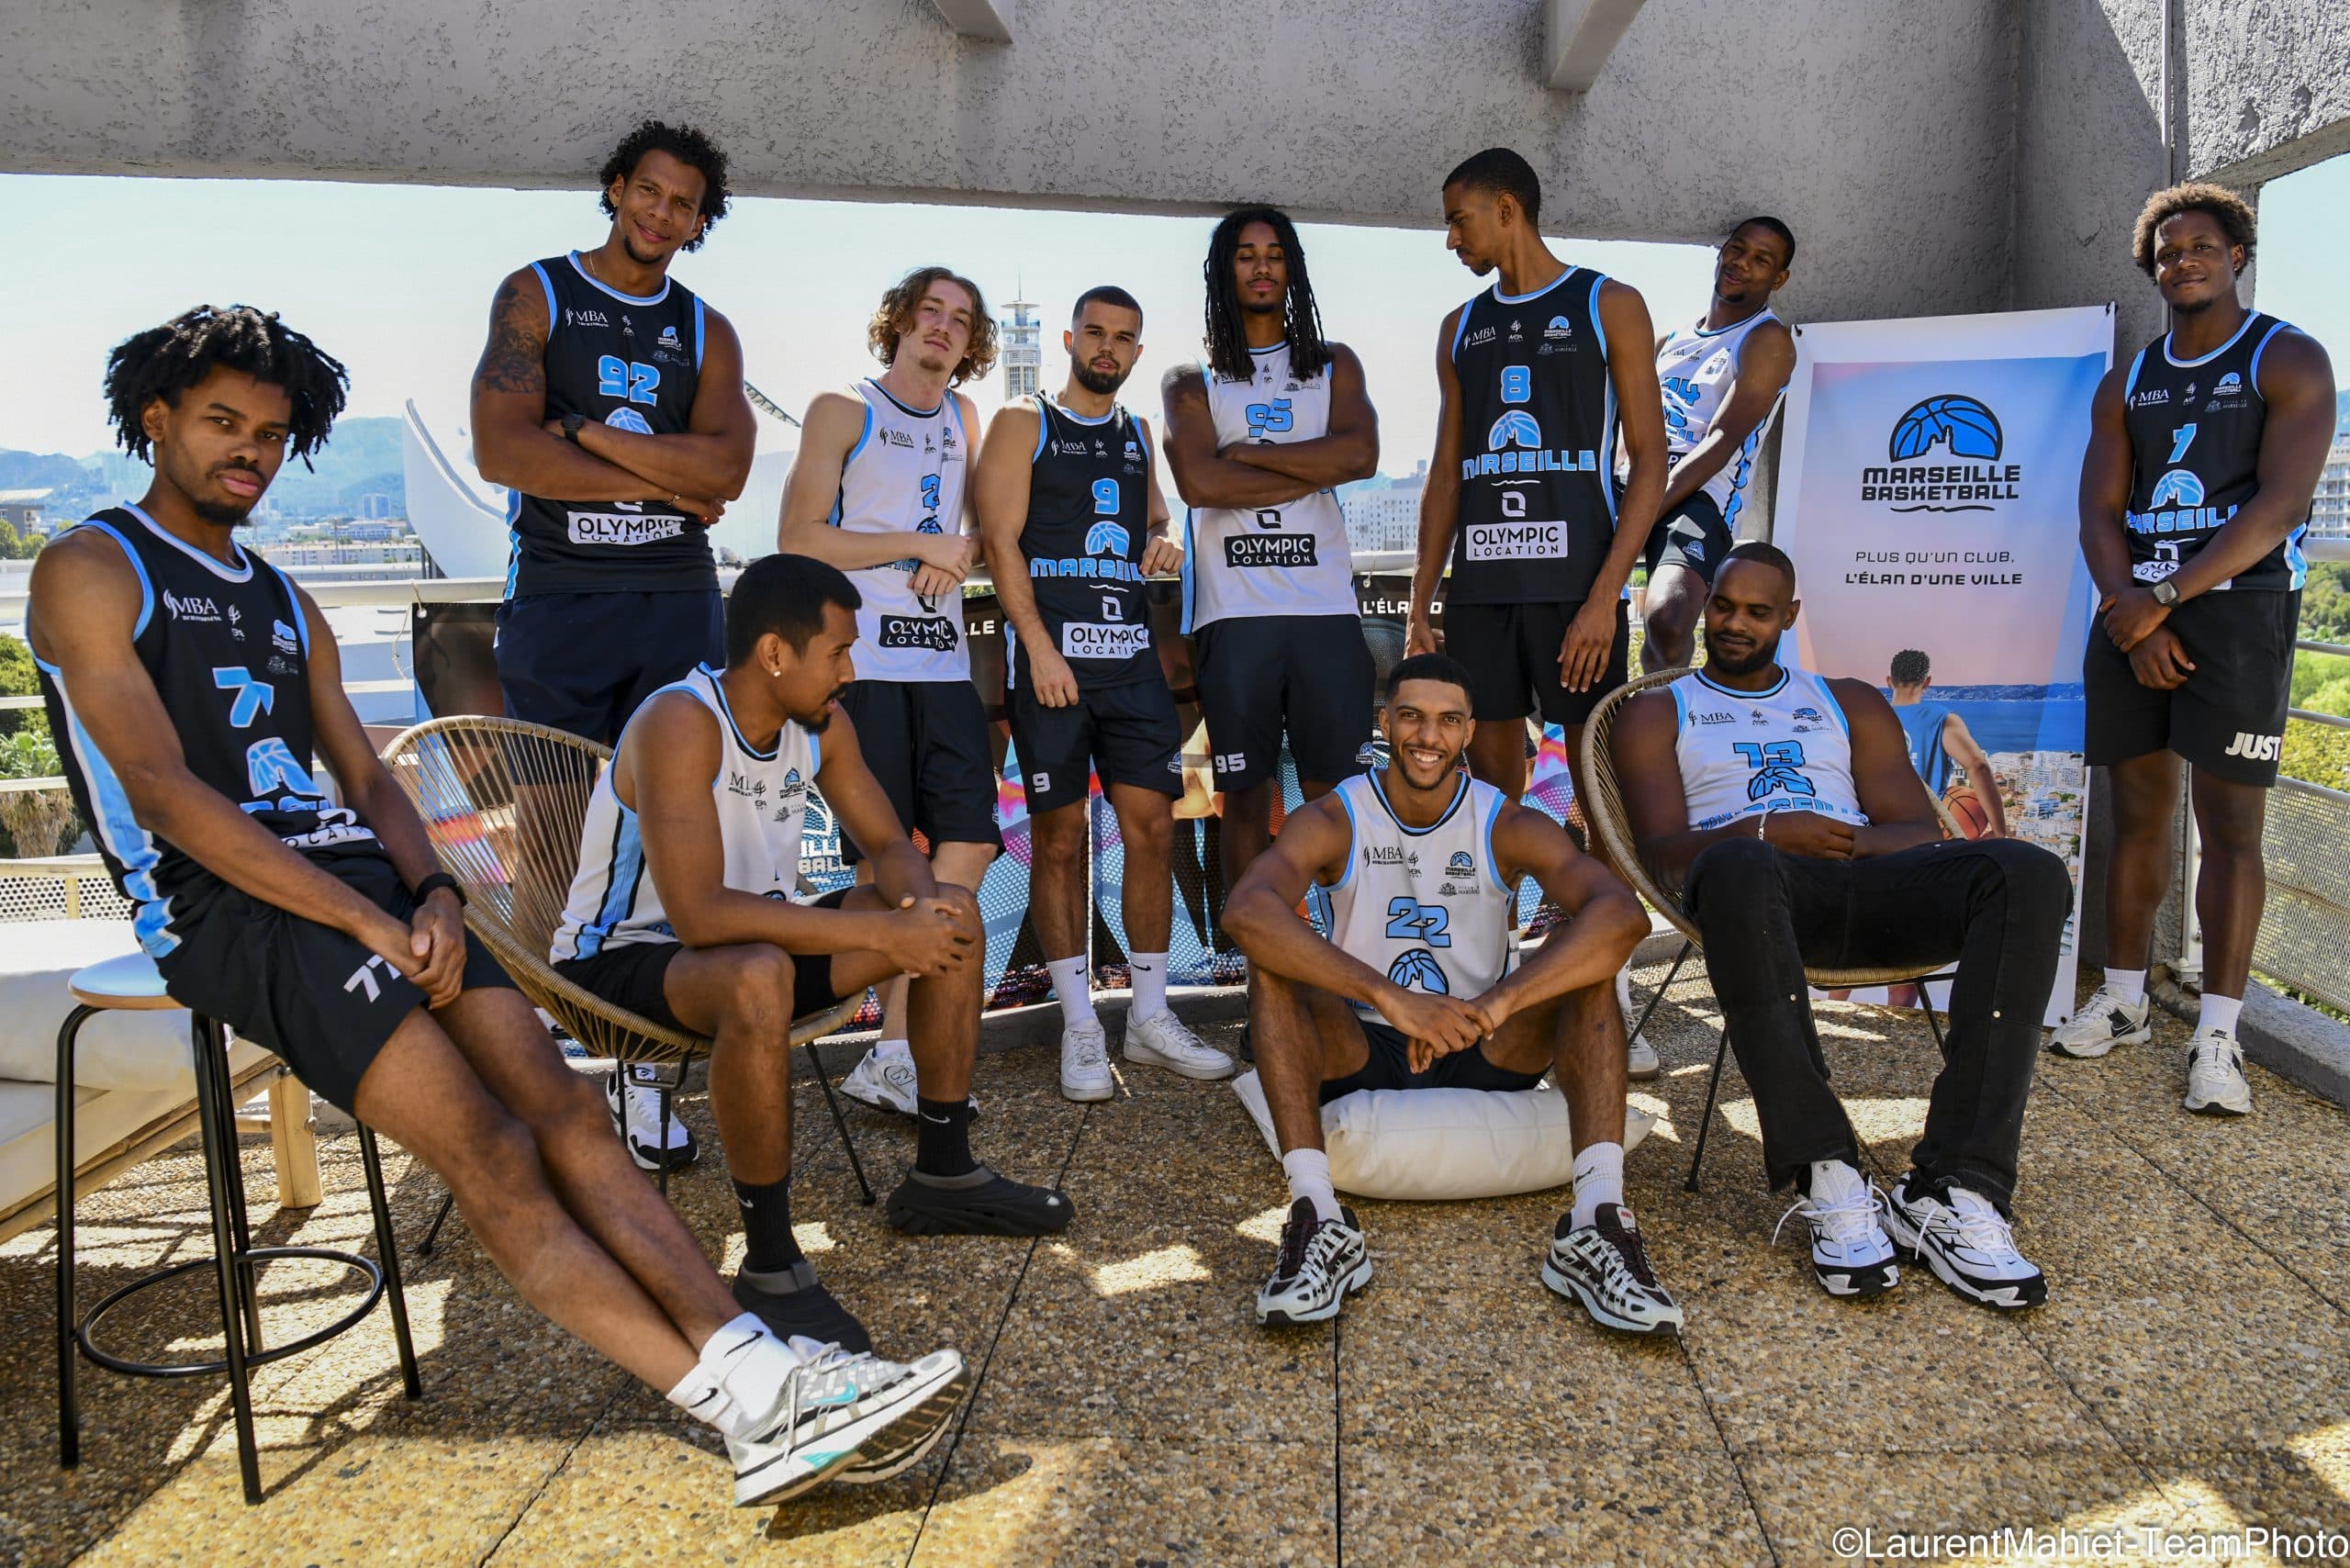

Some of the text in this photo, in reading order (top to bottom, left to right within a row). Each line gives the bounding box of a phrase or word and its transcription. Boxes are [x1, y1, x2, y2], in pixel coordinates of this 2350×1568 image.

[576, 309, 608, 323] MBA
[1472, 326, 1496, 342] MBA
[598, 354, 660, 407] 92
[1501, 365, 1531, 404] 8
[2139, 388, 2170, 402] MBA
[1246, 398, 1293, 438] 95
[890, 429, 914, 445] MBA
[1863, 465, 2020, 484] MARSEILLE
[921, 474, 941, 510] 2
[1091, 477, 1120, 515] 9
[1862, 485, 2020, 500] BASKETBALL
[1472, 526, 1559, 545] OLYMPIC
[1231, 538, 1311, 554] OLYMPIC
[1474, 544, 1559, 557] LOCATION
[1233, 554, 1311, 565] LOCATION
[1855, 551, 2015, 565] PLUS QU'UN CLUB,
[1845, 571, 2023, 585] L'ÉLAN D'UNE VILLE
[173, 597, 219, 615] MBA
[1362, 598, 1410, 614] L'ÉLA
[1070, 627, 1146, 644] OLYMPIC
[1072, 644, 1138, 655] LOCATIO
[1699, 712, 1734, 722] MBA
[2224, 731, 2282, 761] JUST
[1214, 752, 1247, 774] 95
[1033, 771, 1051, 793] 9
[1372, 846, 1404, 859] MBA
[1386, 896, 1451, 947] 22
